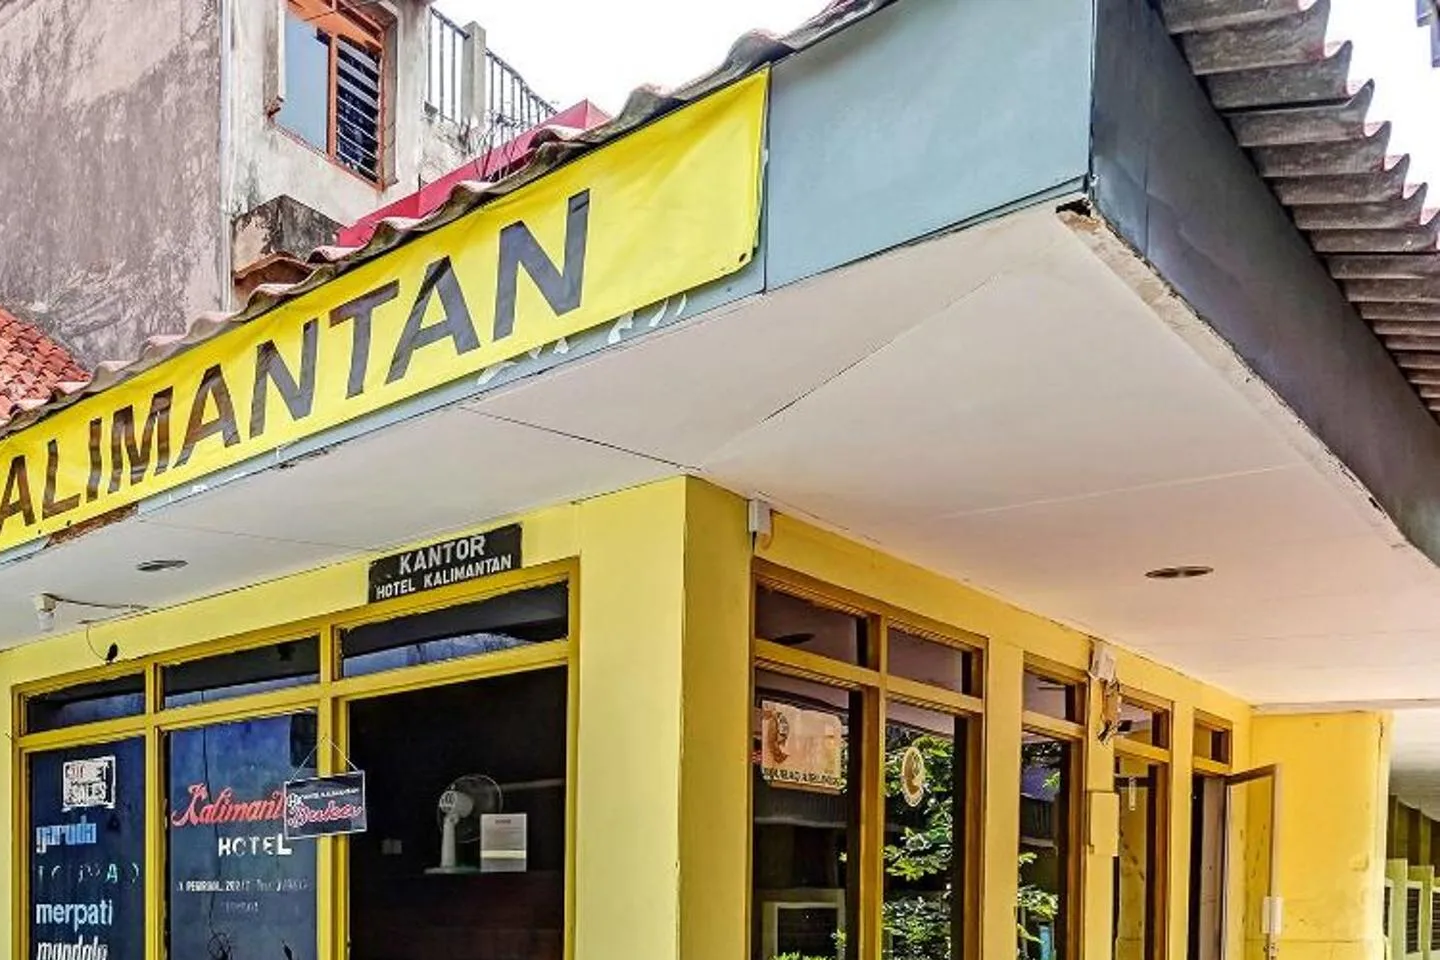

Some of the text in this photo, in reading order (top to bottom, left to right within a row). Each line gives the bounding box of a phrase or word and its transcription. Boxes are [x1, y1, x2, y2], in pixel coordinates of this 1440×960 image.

[399, 534, 487, 576] KANTOR
[375, 553, 512, 600] HOTEL KALIMANTAN
[170, 782, 285, 826] Kalimant
[218, 833, 293, 857] HOTEL
[35, 899, 113, 933] merpati
